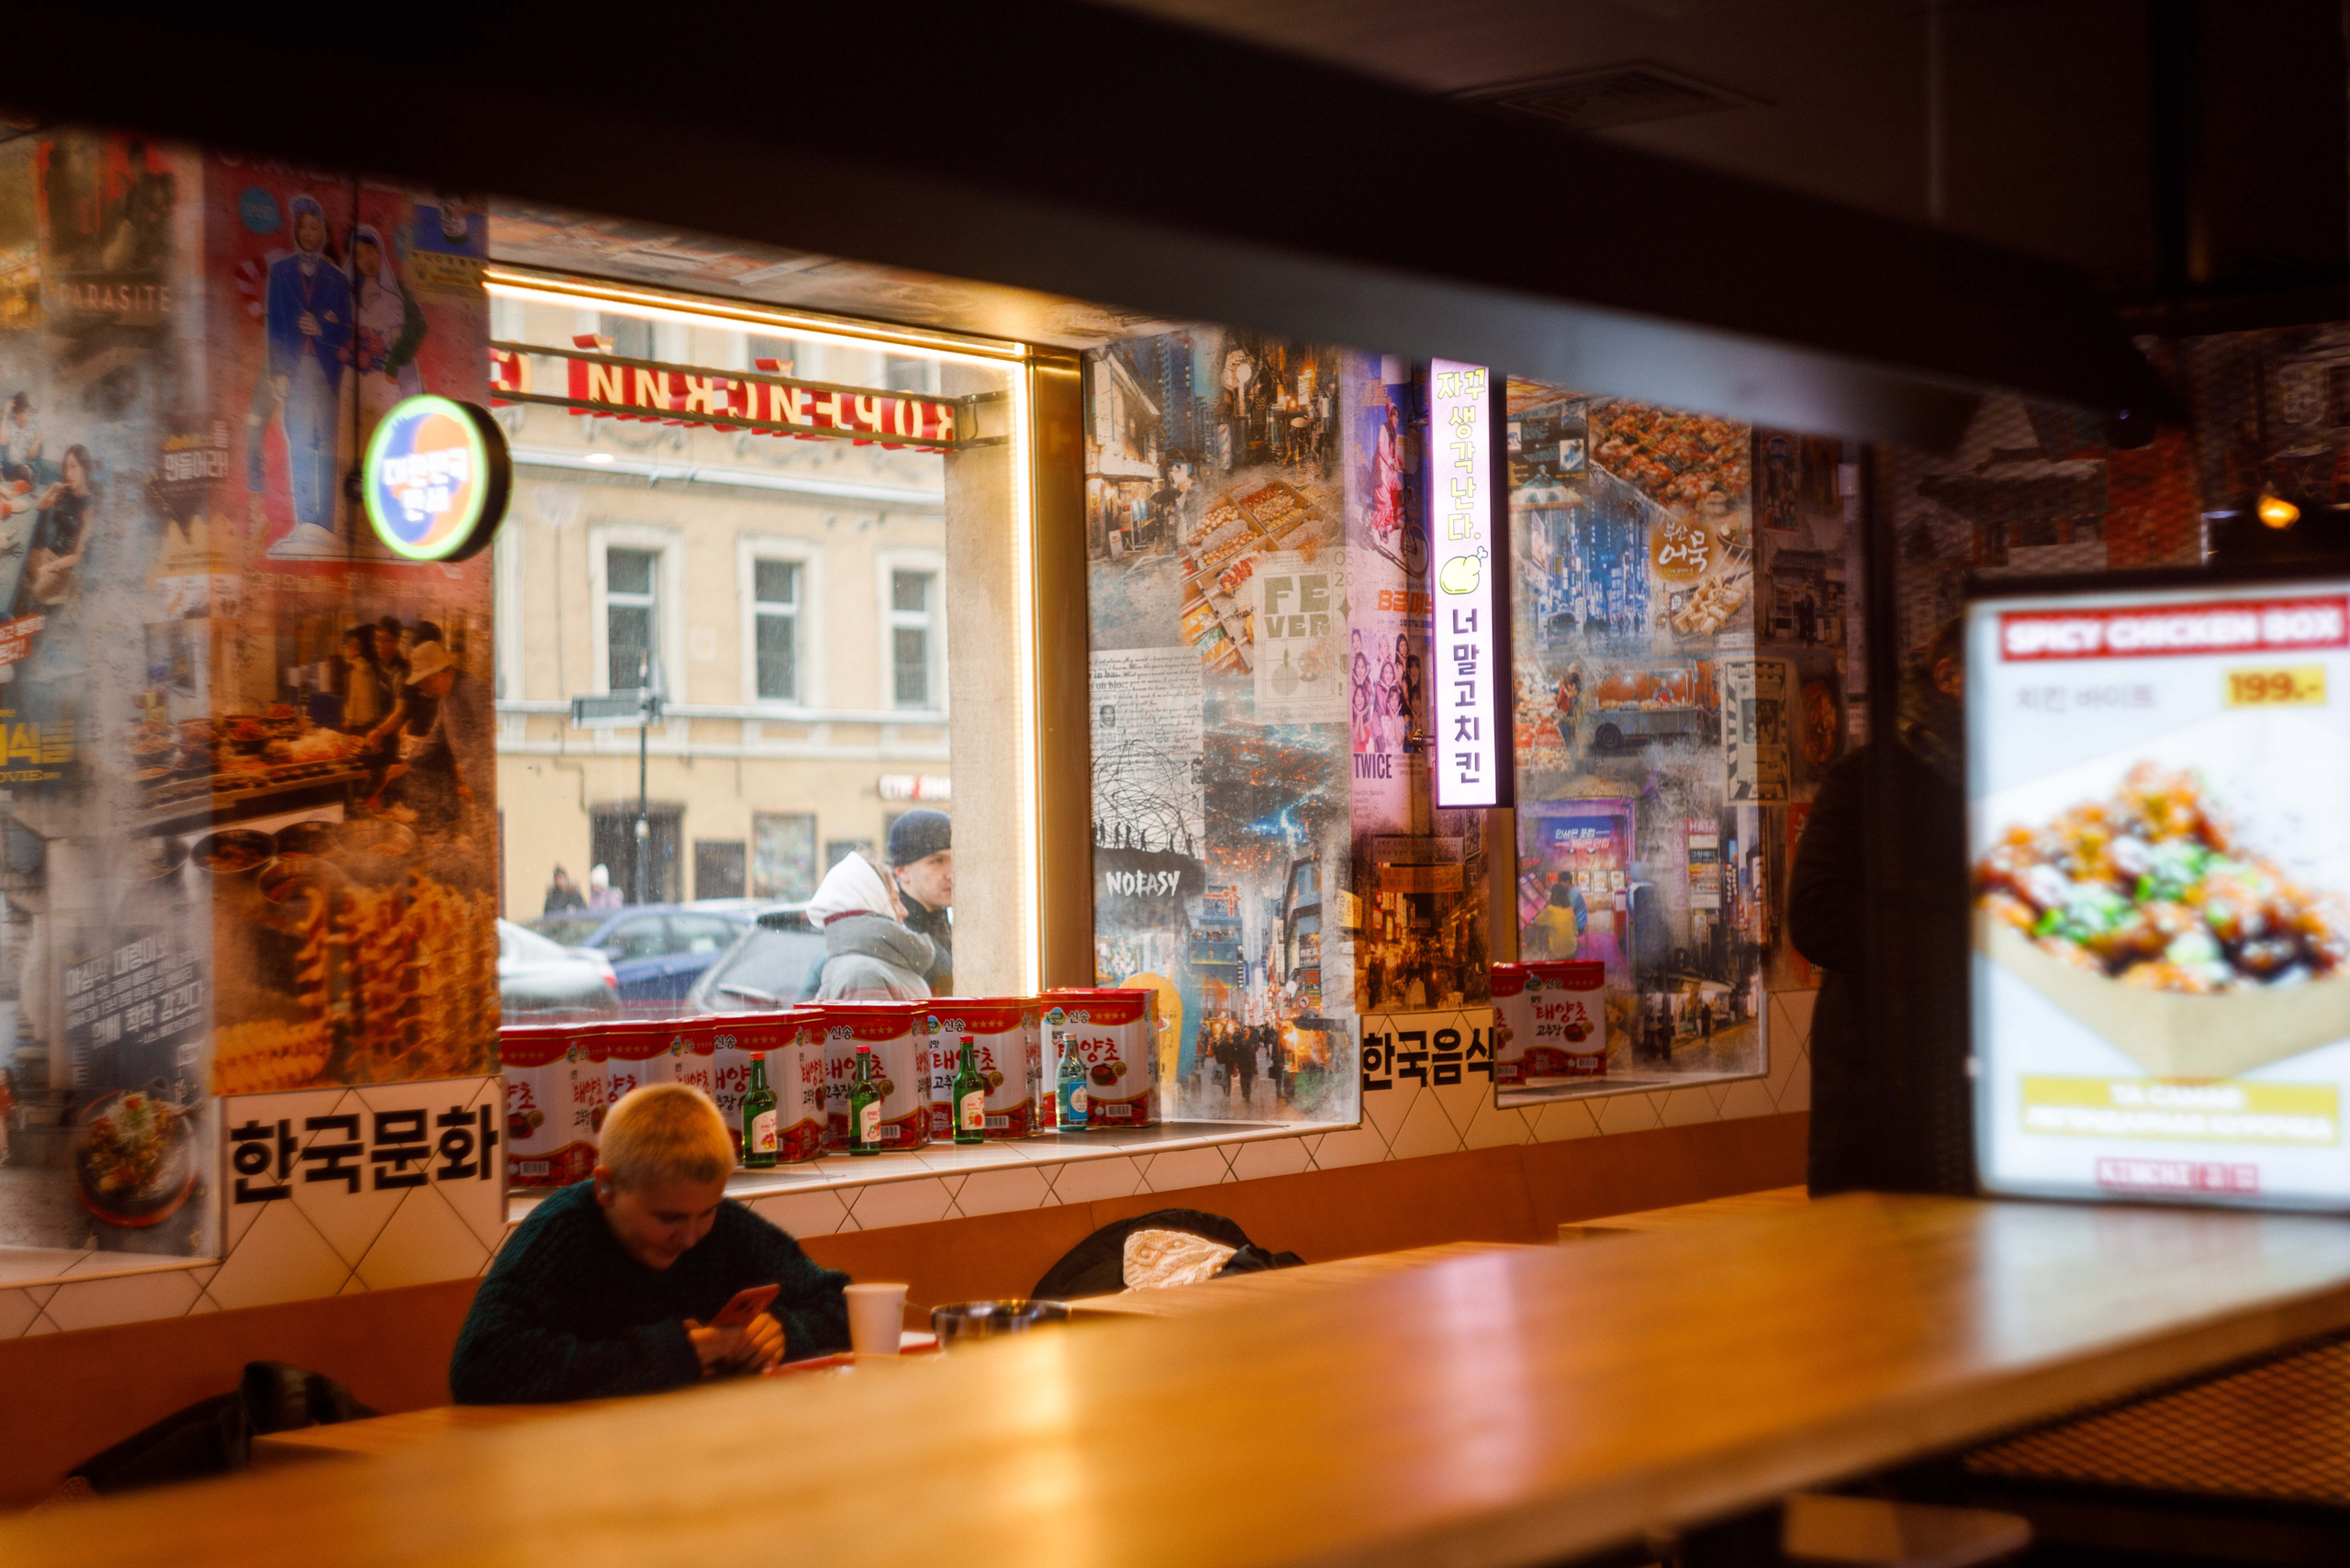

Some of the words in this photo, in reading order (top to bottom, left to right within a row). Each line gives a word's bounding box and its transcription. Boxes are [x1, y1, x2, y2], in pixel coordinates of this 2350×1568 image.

[60, 282, 171, 312] PARASITE
[1438, 368, 1485, 400] 자꾸
[1663, 521, 1688, 543] 부산
[1659, 530, 1709, 573] 어묵
[2007, 620, 2102, 654] SPICY
[2107, 612, 2257, 648] CHICKEN
[2262, 606, 2341, 643] BOX
[2075, 683, 2154, 709] 바이트
[1353, 753, 1393, 779] TWICE
[1105, 869, 1181, 898] NOEASY
[126, 1000, 157, 1033] 착착
[943, 1018, 966, 1033] 신송
[1069, 1010, 1091, 1024] 신송
[1535, 1000, 1589, 1024] 태양초
[714, 1034, 737, 1049] 신송
[830, 1025, 855, 1040] 신송
[1363, 1027, 1494, 1092] 한국음식
[229, 1104, 499, 1204] 한국문화
